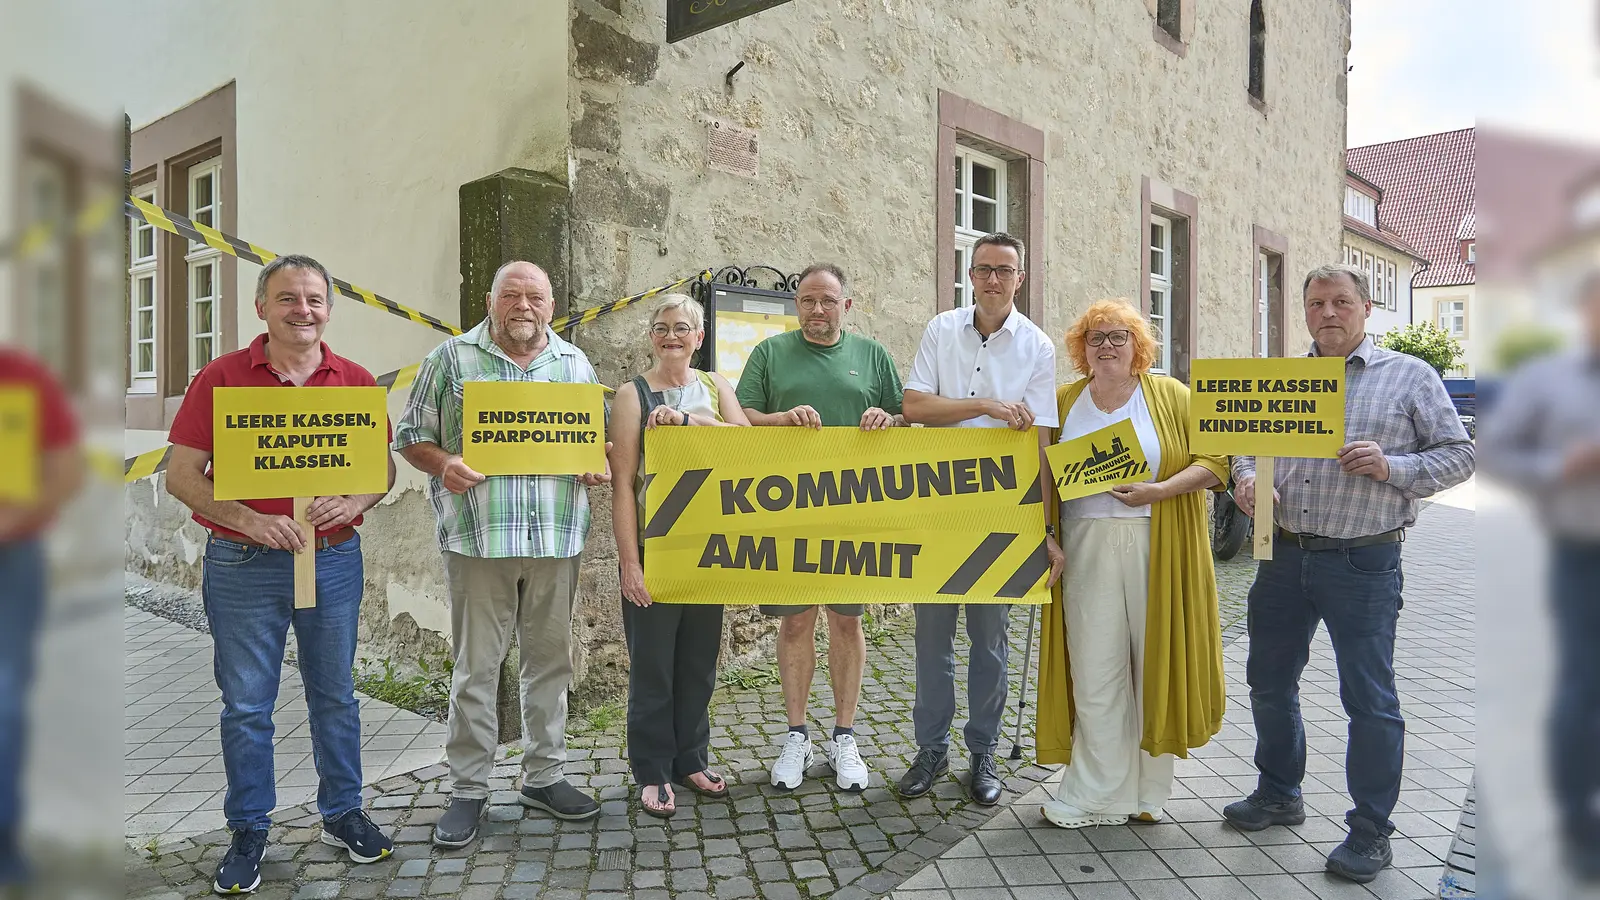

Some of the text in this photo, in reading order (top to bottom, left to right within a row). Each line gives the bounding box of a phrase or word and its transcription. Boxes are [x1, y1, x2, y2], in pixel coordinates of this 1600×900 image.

[1196, 379, 1338, 393] LEERE KASSEN
[1215, 399, 1316, 413] SIND KEIN
[226, 413, 377, 430] LEERE KASSEN,
[478, 410, 591, 425] ENDSTATION
[1199, 419, 1334, 435] KINDERSPIEL.
[258, 433, 348, 449] KAPUTTE
[471, 430, 598, 445] SPARPOLITIK?
[254, 454, 352, 470] KLASSEN.
[1083, 453, 1131, 477] KOMMUNEN
[720, 454, 1018, 516] KOMMUNEN
[1084, 471, 1122, 485] AM LIMIT
[697, 533, 922, 579] AM LIMIT
